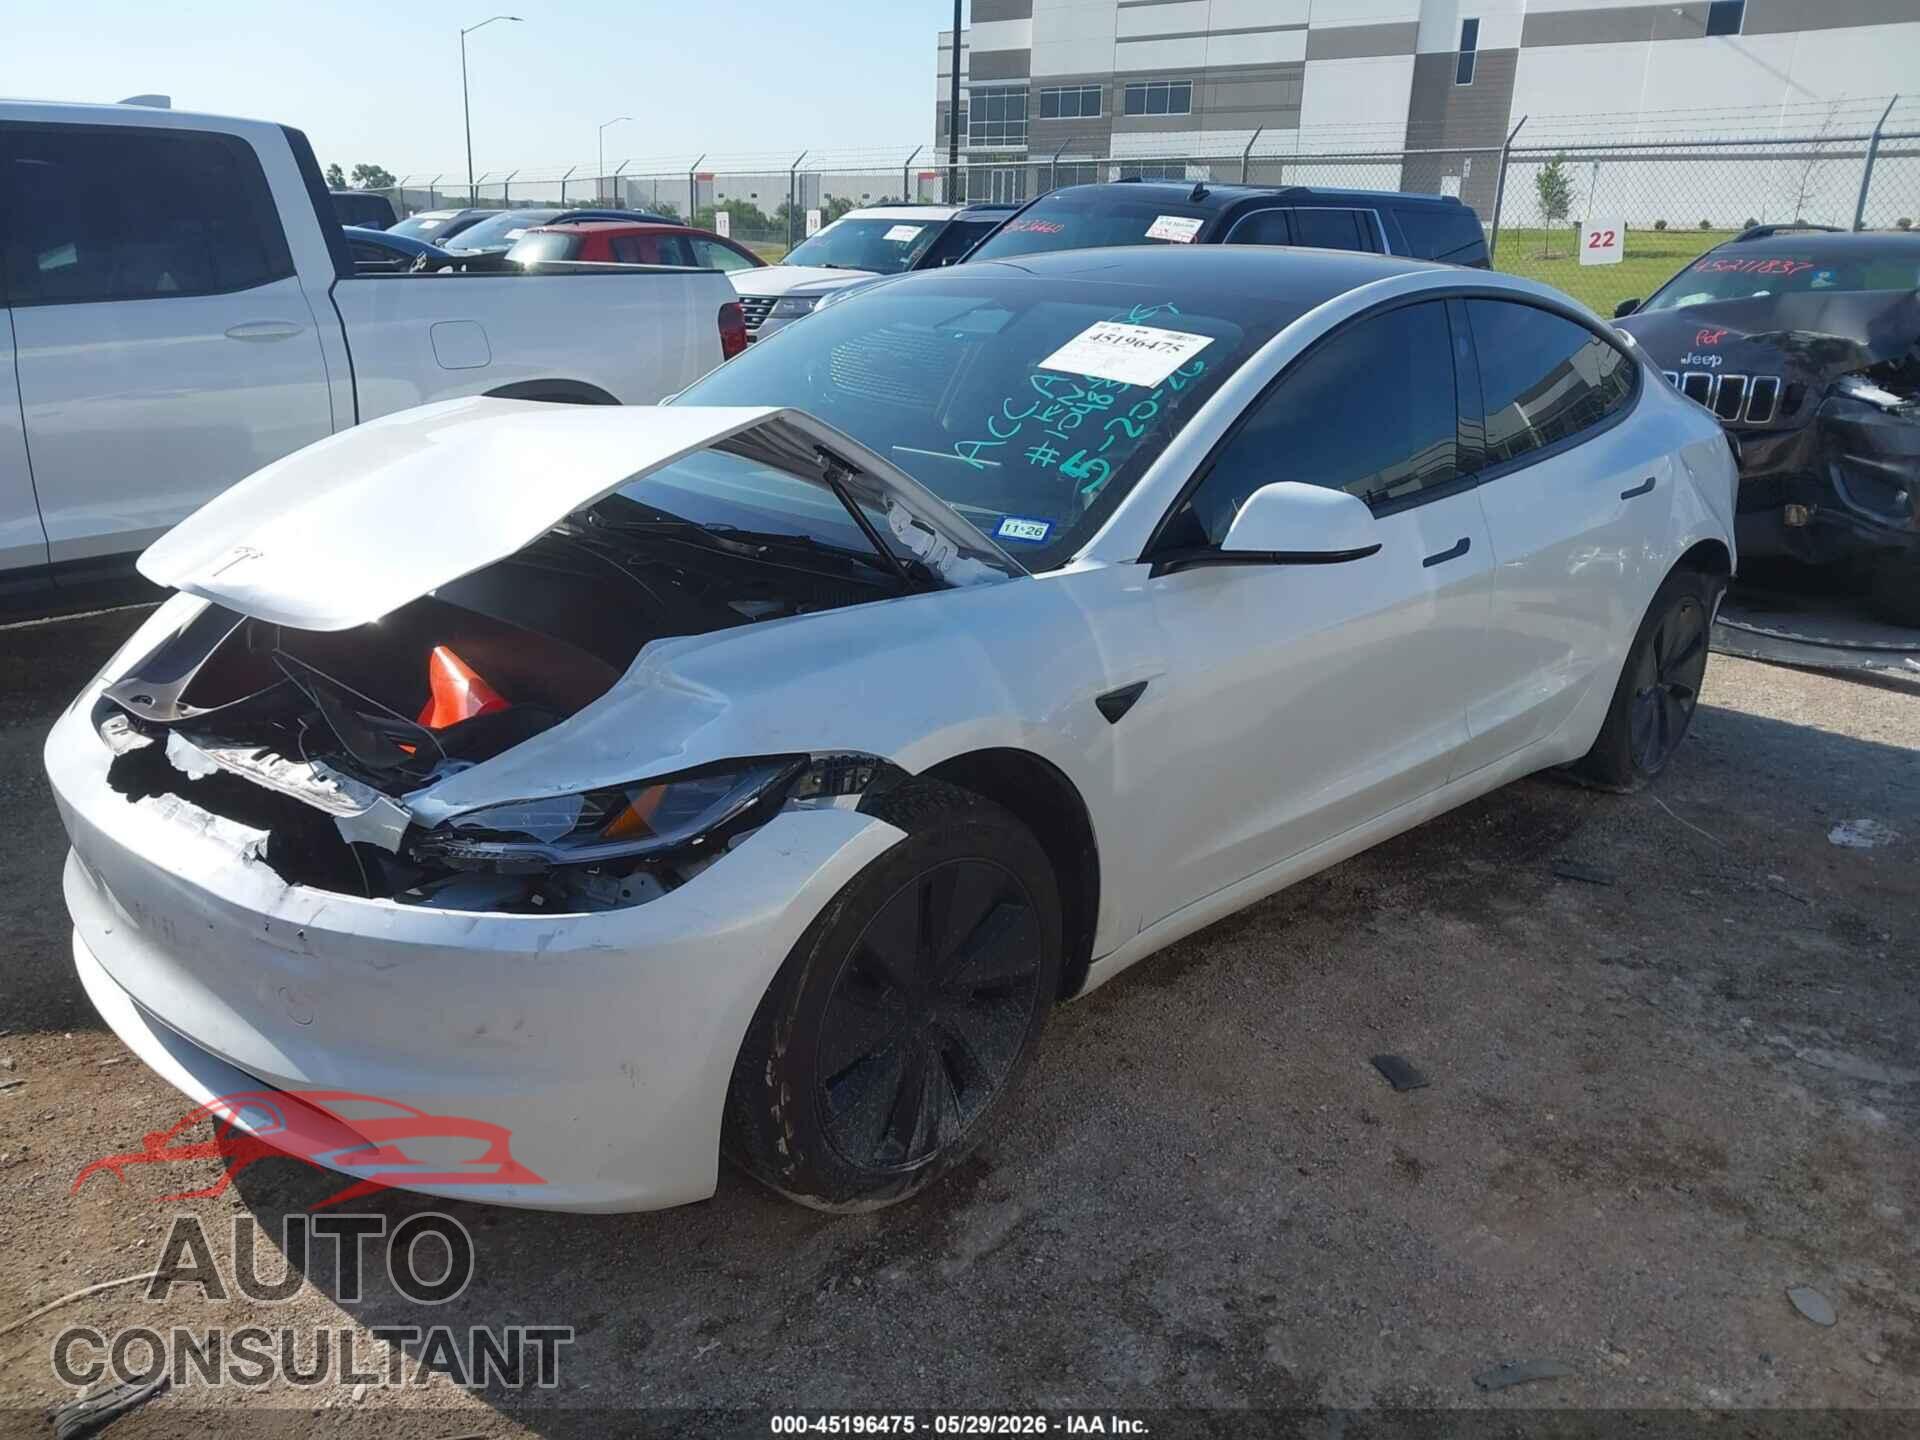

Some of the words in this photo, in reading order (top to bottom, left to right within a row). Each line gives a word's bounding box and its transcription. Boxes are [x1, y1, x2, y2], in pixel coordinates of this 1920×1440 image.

[1589, 231, 1615, 248] 22
[1090, 333, 1184, 353] 45196475
[1681, 352, 1722, 367] Jeep
